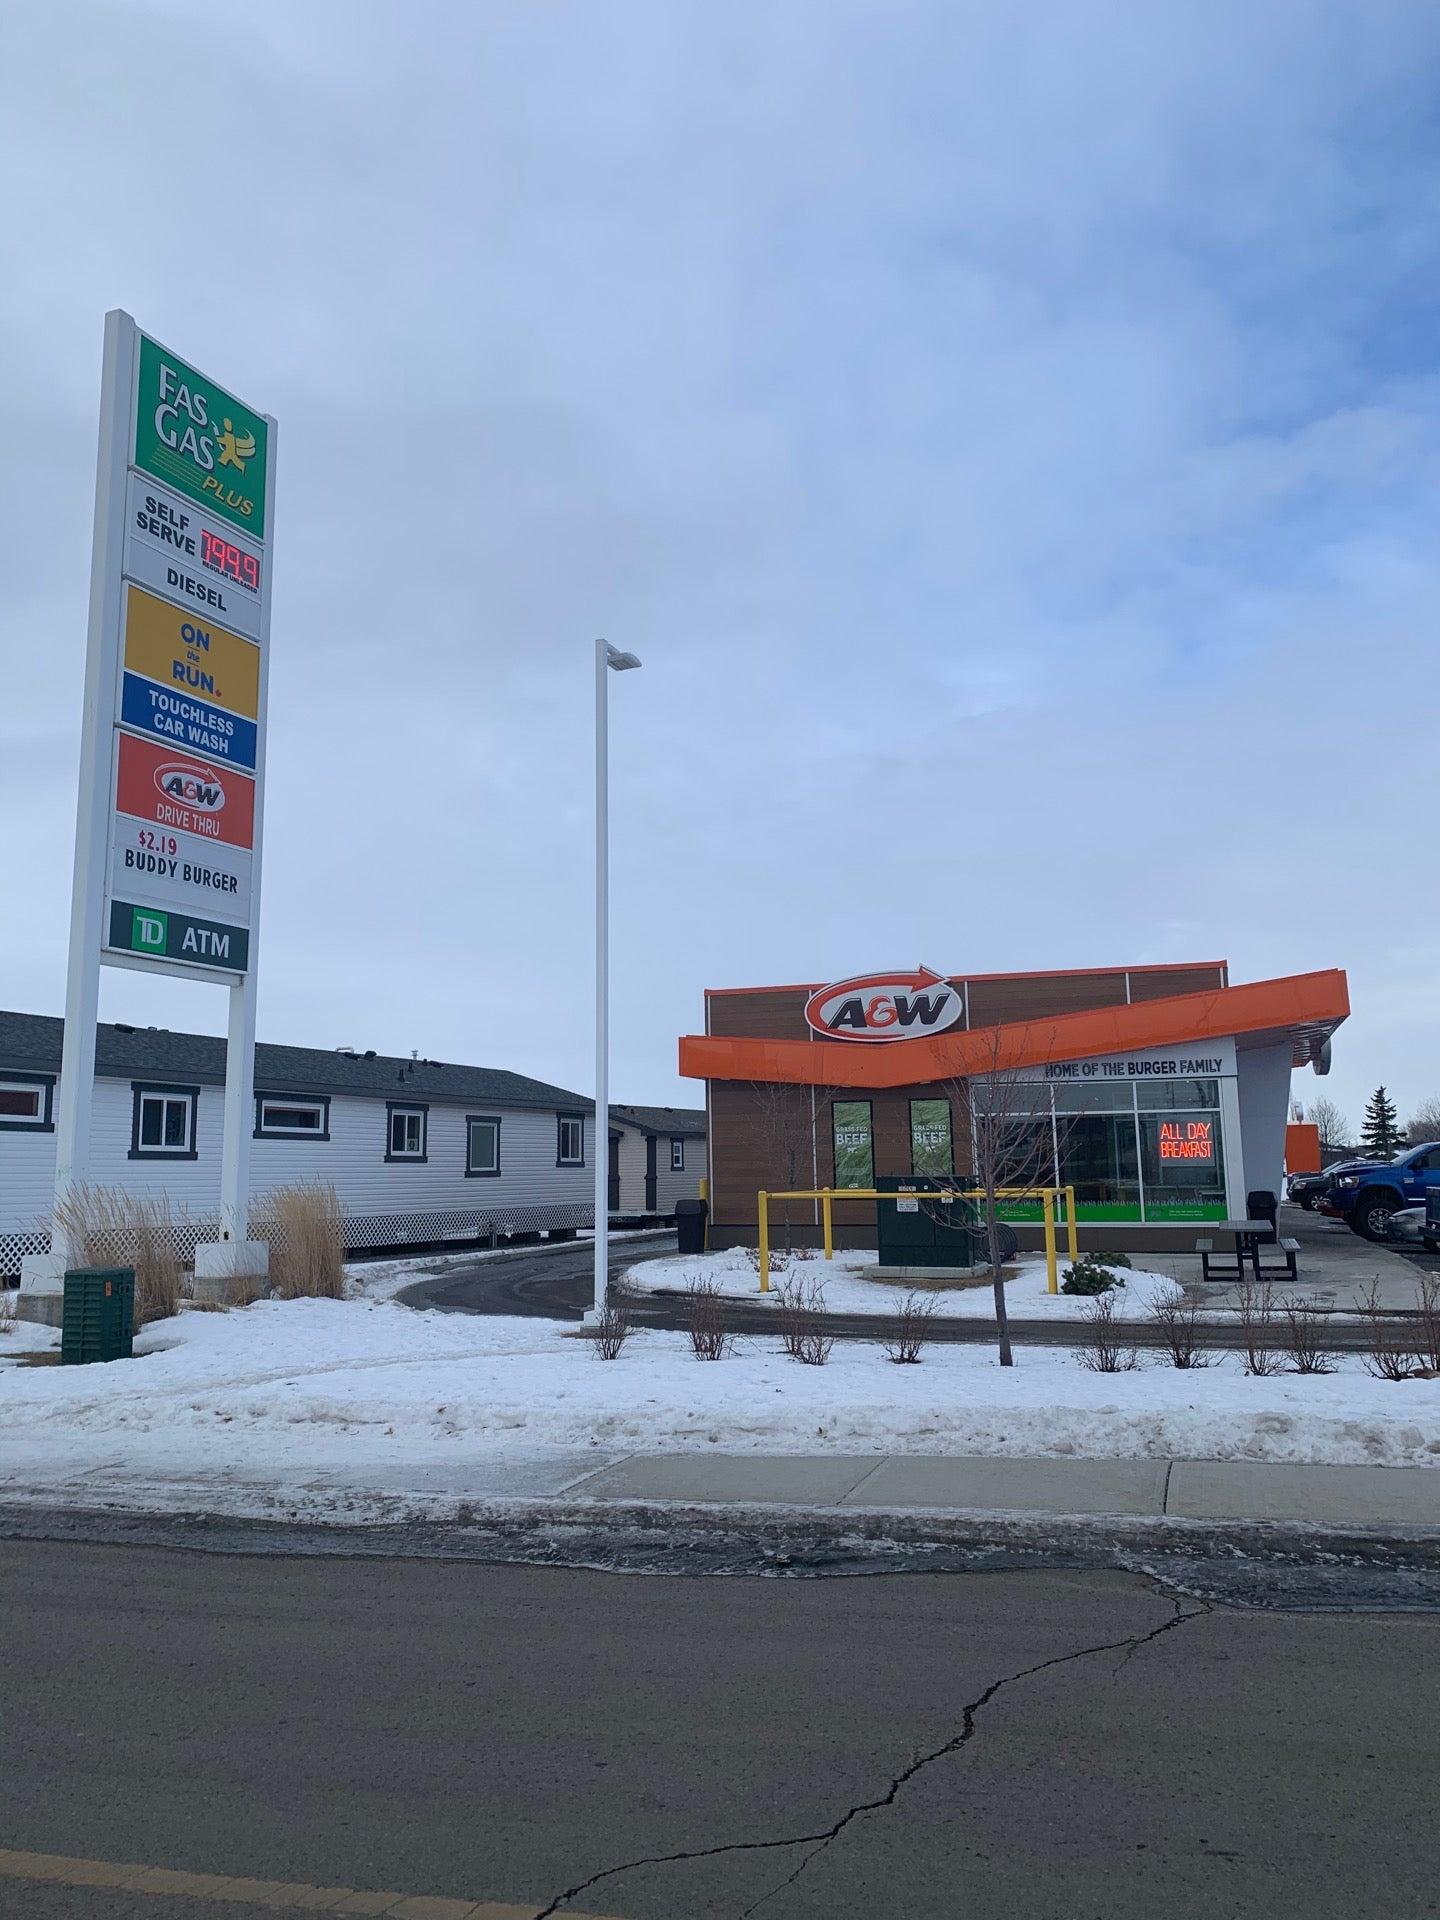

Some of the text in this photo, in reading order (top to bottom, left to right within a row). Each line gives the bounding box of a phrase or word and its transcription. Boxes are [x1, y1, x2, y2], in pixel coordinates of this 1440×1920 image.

[159, 363, 208, 427] FAS
[154, 403, 215, 471] GAS
[145, 495, 190, 531] SELF
[202, 475, 255, 516] PLUS
[136, 511, 196, 557] SERVE
[167, 567, 227, 612] DIESEL
[202, 560, 258, 594] REGULAR UNLEADED
[180, 623, 210, 652] ON
[186, 650, 200, 663] the
[148, 689, 235, 737] TOUCHLESS
[153, 713, 229, 754] CAR WASH
[165, 775, 221, 807] A&W
[156, 803, 220, 836] DRIVE THRU
[138, 829, 177, 856] $2.19
[125, 848, 238, 894] BUDDY BURGER
[136, 915, 230, 959] TD ATM
[826, 992, 951, 1029] A&W
[1045, 1058, 1223, 1079] HOME OF THE BURGER FAMILY
[836, 1133, 868, 1145] BEEF
[913, 1131, 947, 1144] BEEF
[1160, 1122, 1212, 1140] ALL DAY
[1160, 1140, 1213, 1159] BREAKFAST
